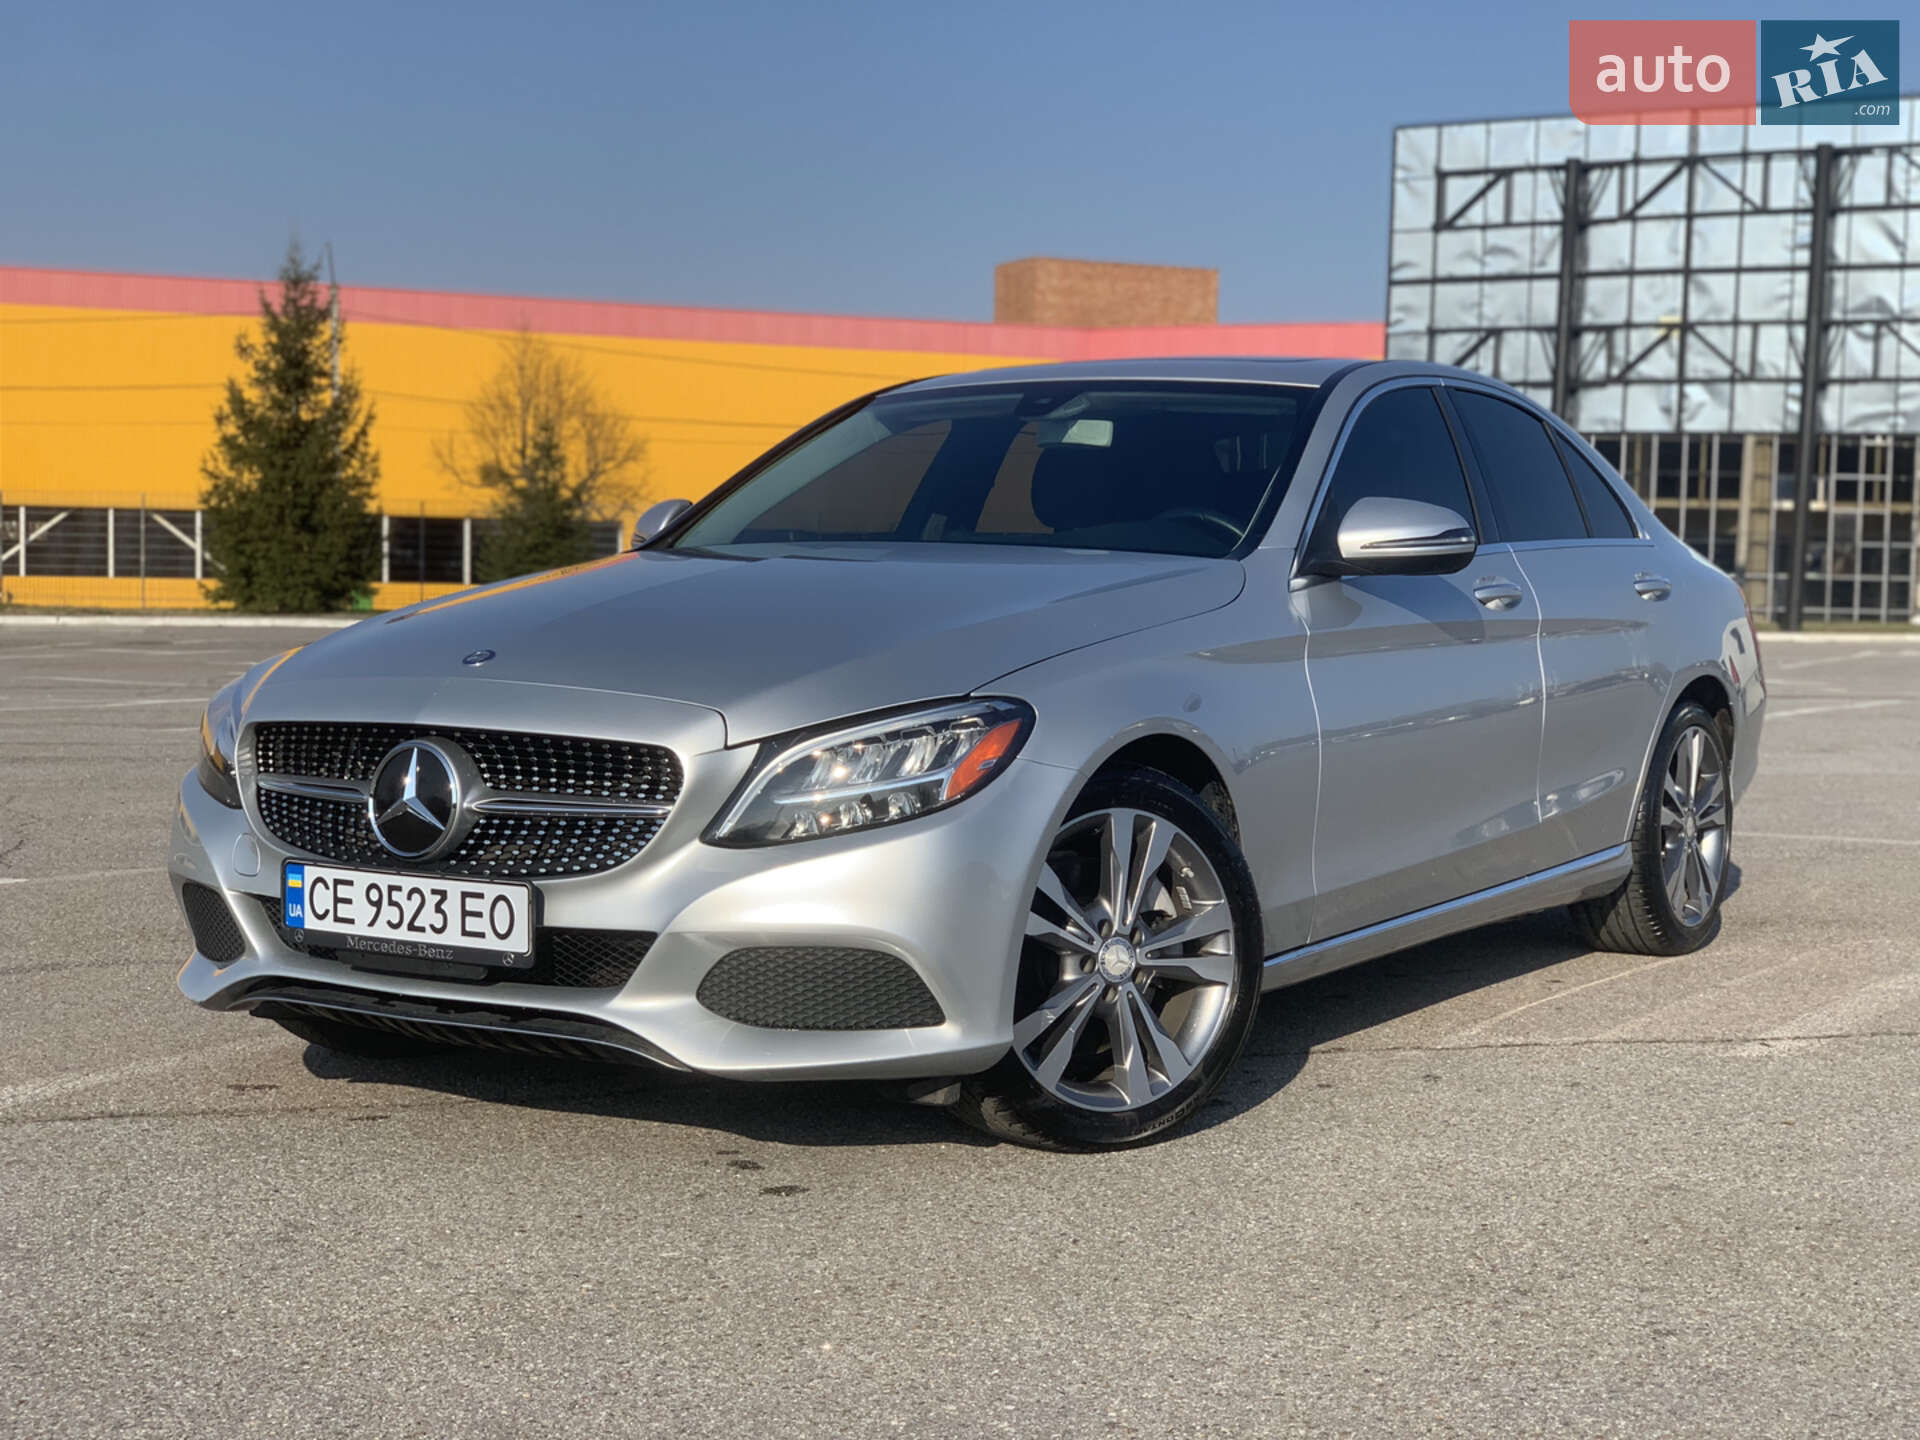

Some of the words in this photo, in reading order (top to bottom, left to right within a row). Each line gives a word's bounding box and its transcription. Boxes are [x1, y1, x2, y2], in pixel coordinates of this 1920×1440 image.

[288, 903, 304, 918] UA
[309, 876, 355, 925] CE
[365, 883, 449, 935] 9523
[460, 891, 515, 940] EO
[345, 935, 454, 960] Mercedes-Benz
